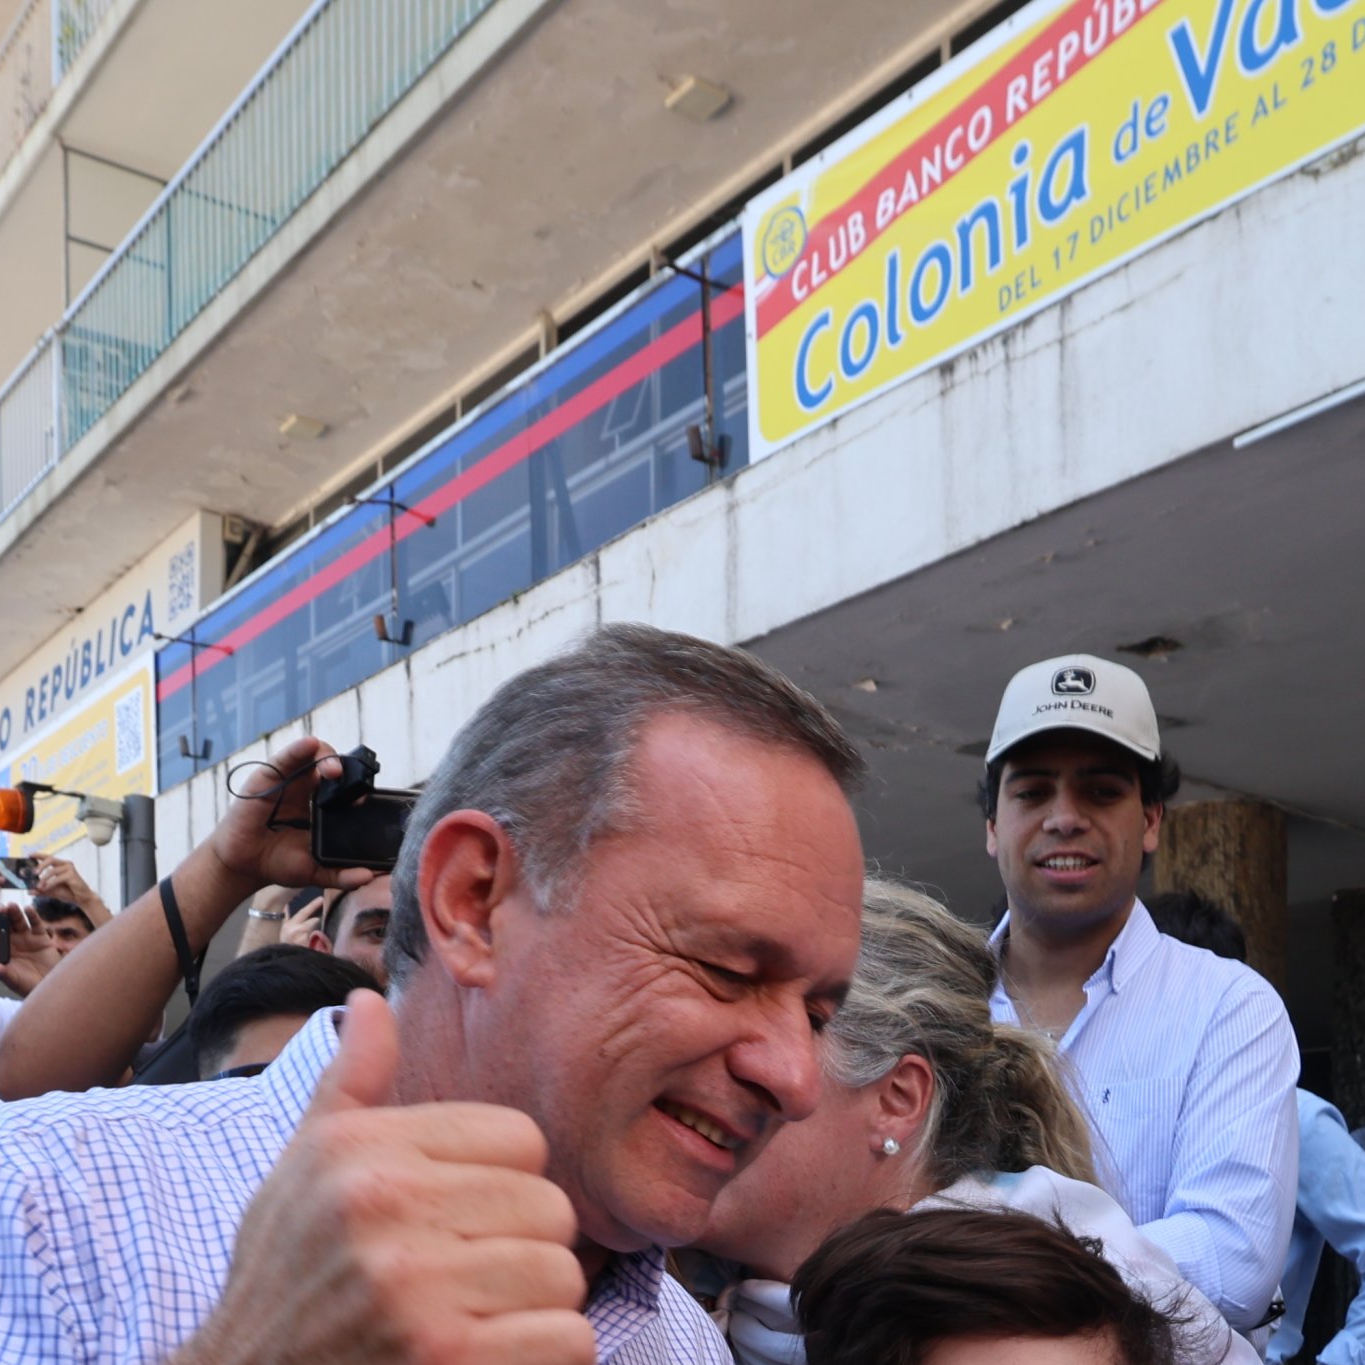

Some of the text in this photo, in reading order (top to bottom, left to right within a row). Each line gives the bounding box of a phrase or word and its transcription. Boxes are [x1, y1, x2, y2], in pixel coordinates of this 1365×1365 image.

[791, 0, 1161, 301] CLUB BANCO REPÚB
[795, 0, 1352, 410] Colonia de Va
[998, 265, 1041, 312] DEL
[1052, 231, 1079, 270] 17
[1089, 112, 1239, 245] DICIEMBRE
[1251, 82, 1288, 126] AL
[1300, 41, 1336, 90] 28
[23, 590, 154, 732] REPÚBLICA
[1032, 700, 1114, 718] JOHN DEERE
